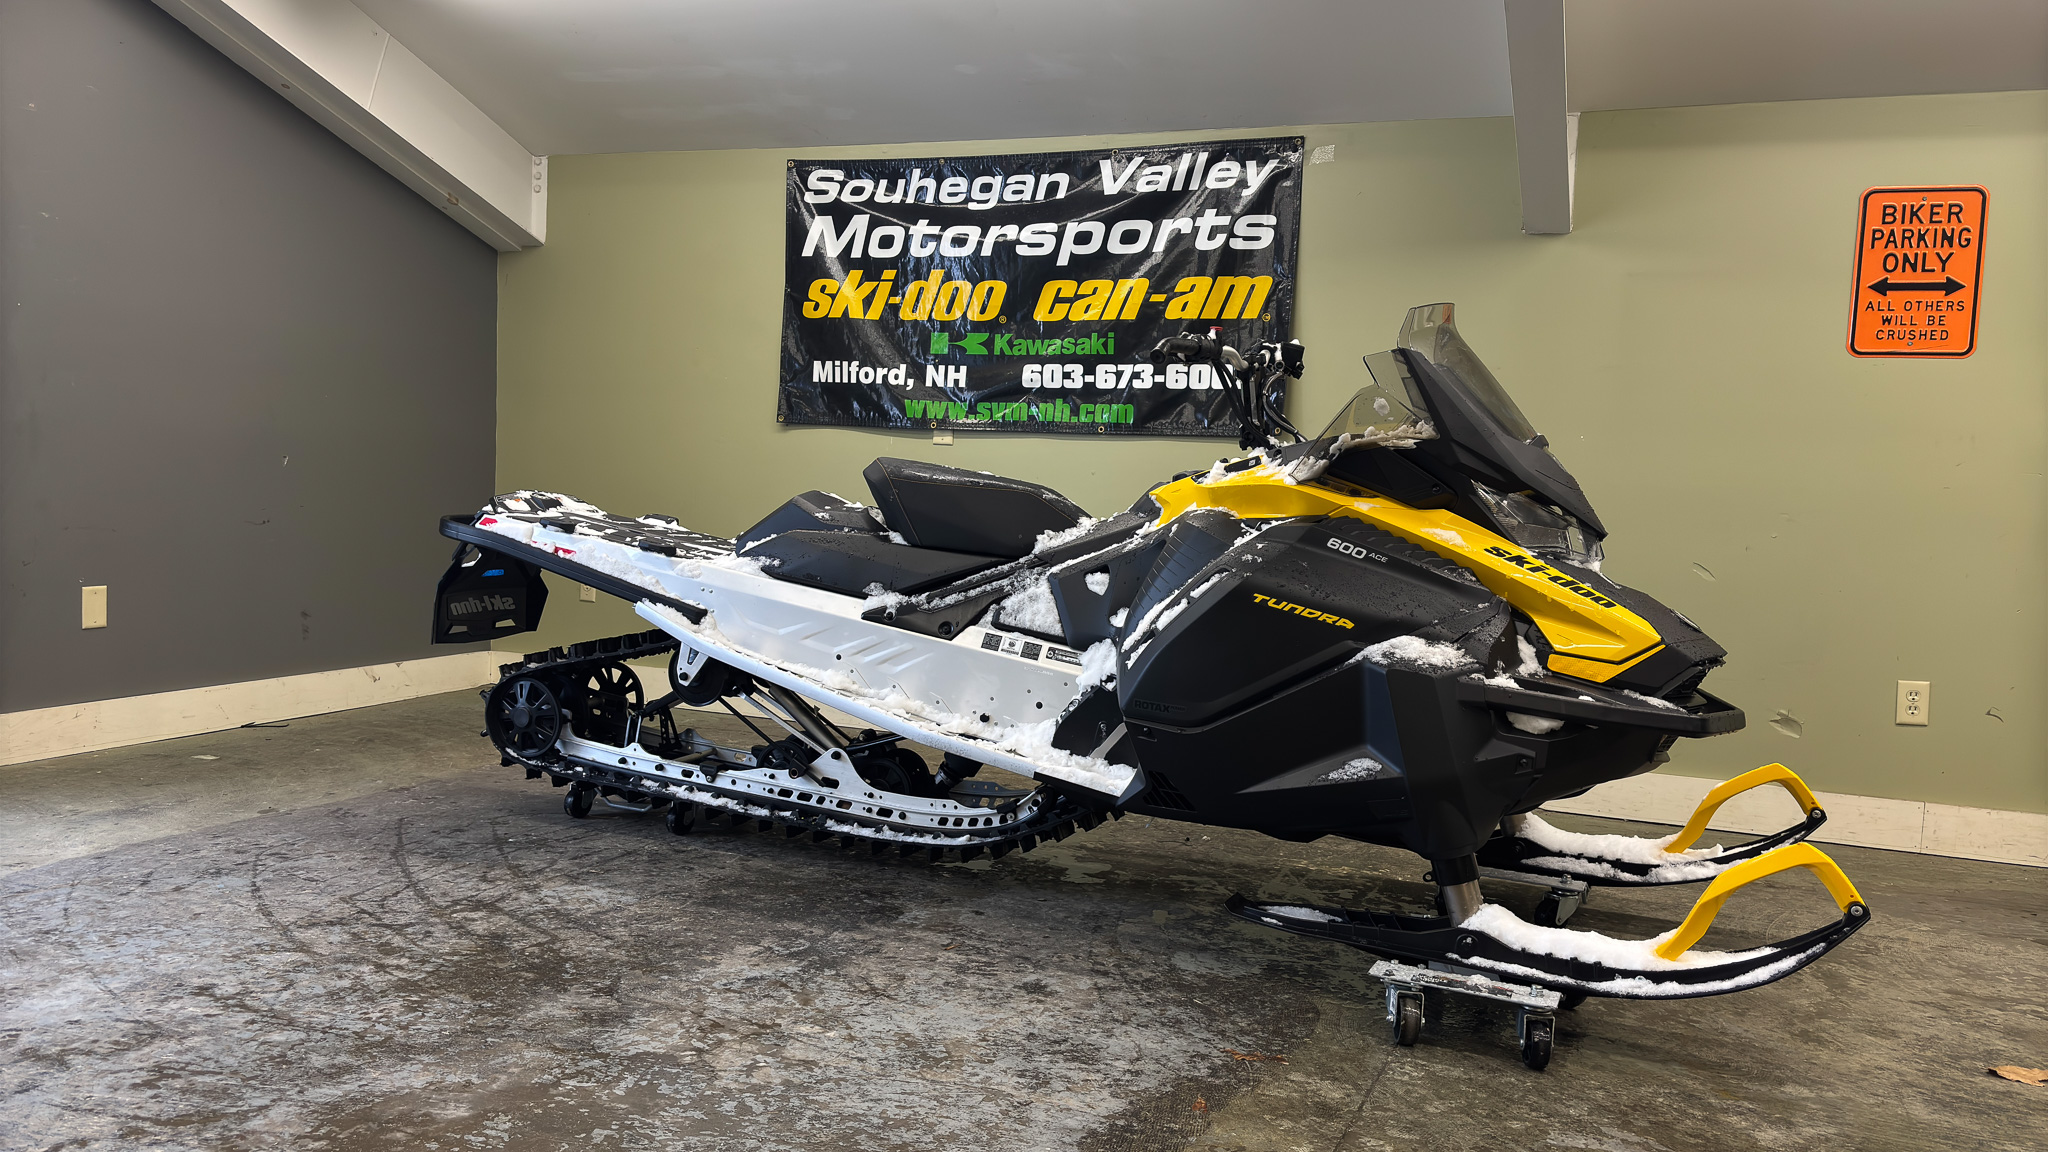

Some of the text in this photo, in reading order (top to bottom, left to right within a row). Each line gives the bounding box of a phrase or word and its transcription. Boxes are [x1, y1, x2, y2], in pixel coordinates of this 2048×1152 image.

[803, 151, 1279, 211] Souhegan Valley
[1881, 203, 1964, 225] BIKER
[801, 207, 1278, 266] Motorsports
[1870, 227, 1972, 249] PARKING
[1882, 252, 1955, 273] ONLY
[802, 269, 1274, 322] ski-doo can-am
[1865, 300, 1965, 312] ALL OTHERS
[1881, 315, 1947, 326] WILL BE
[994, 332, 1115, 356] Kawasaki
[1875, 329, 1949, 341] CRUSHED
[812, 360, 1242, 390] Milford, NH 603-673-600
[904, 396, 1134, 424] www.svm-nh.com
[1326, 537, 1389, 563] 600 ACE
[1483, 546, 1617, 609] ski-doo
[1253, 593, 1355, 630] TUNDRA
[1134, 700, 1170, 713] ROTAX
